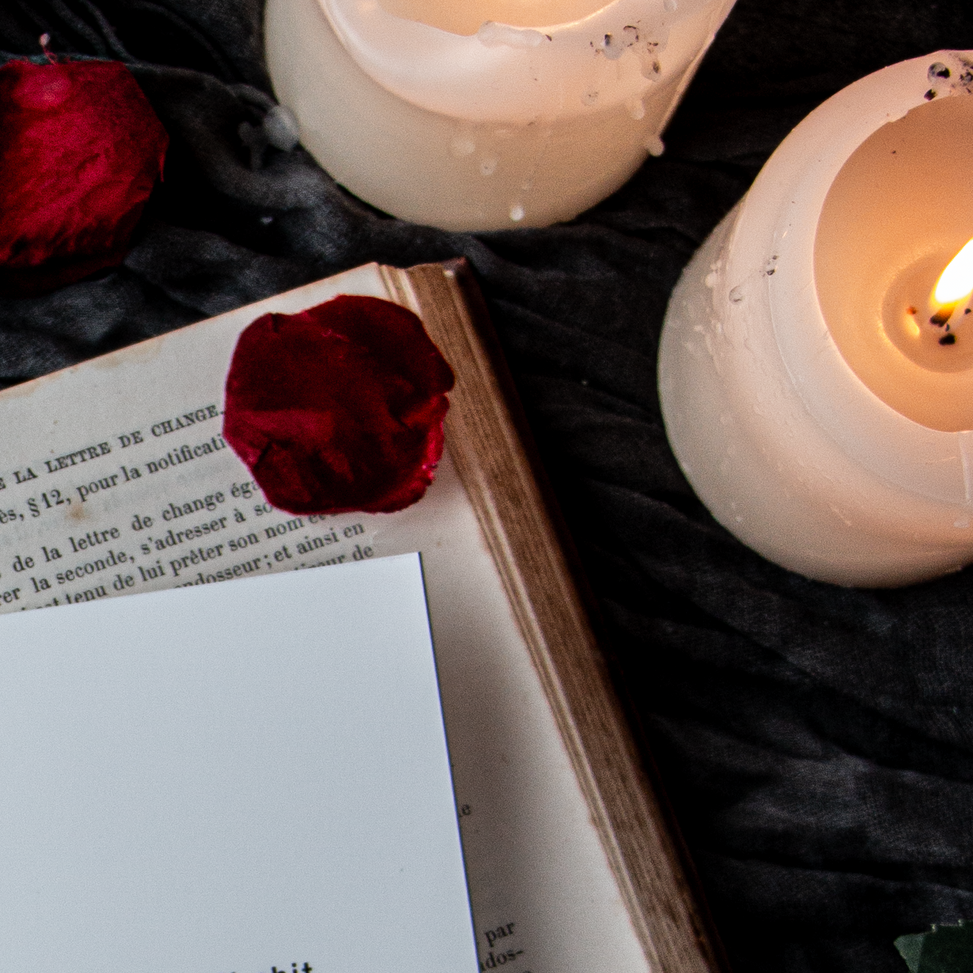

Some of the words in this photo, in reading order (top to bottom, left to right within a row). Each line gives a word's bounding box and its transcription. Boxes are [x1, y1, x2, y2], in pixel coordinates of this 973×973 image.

[13, 468, 38, 484] LA
[44, 442, 112, 474] LETTRE
[118, 431, 144, 449] DE
[76, 472, 118, 503] pour
[121, 464, 142, 482] la
[12, 555, 35, 573] de
[41, 546, 63, 563] la
[69, 525, 121, 553] lettre
[131, 515, 154, 533] de
[162, 491, 226, 522] change
[30, 576, 51, 593] la
[56, 549, 136, 585] seconde,
[234, 508, 246, 524] à
[113, 574, 135, 592] de
[137, 560, 166, 582] lui
[169, 543, 224, 577] prêter
[229, 532, 260, 551] son
[264, 517, 305, 539] nom
[273, 545, 292, 563] et
[296, 527, 339, 555] ainsi
[343, 522, 366, 539] en
[352, 544, 374, 561] de
[484, 921, 516, 948] par
